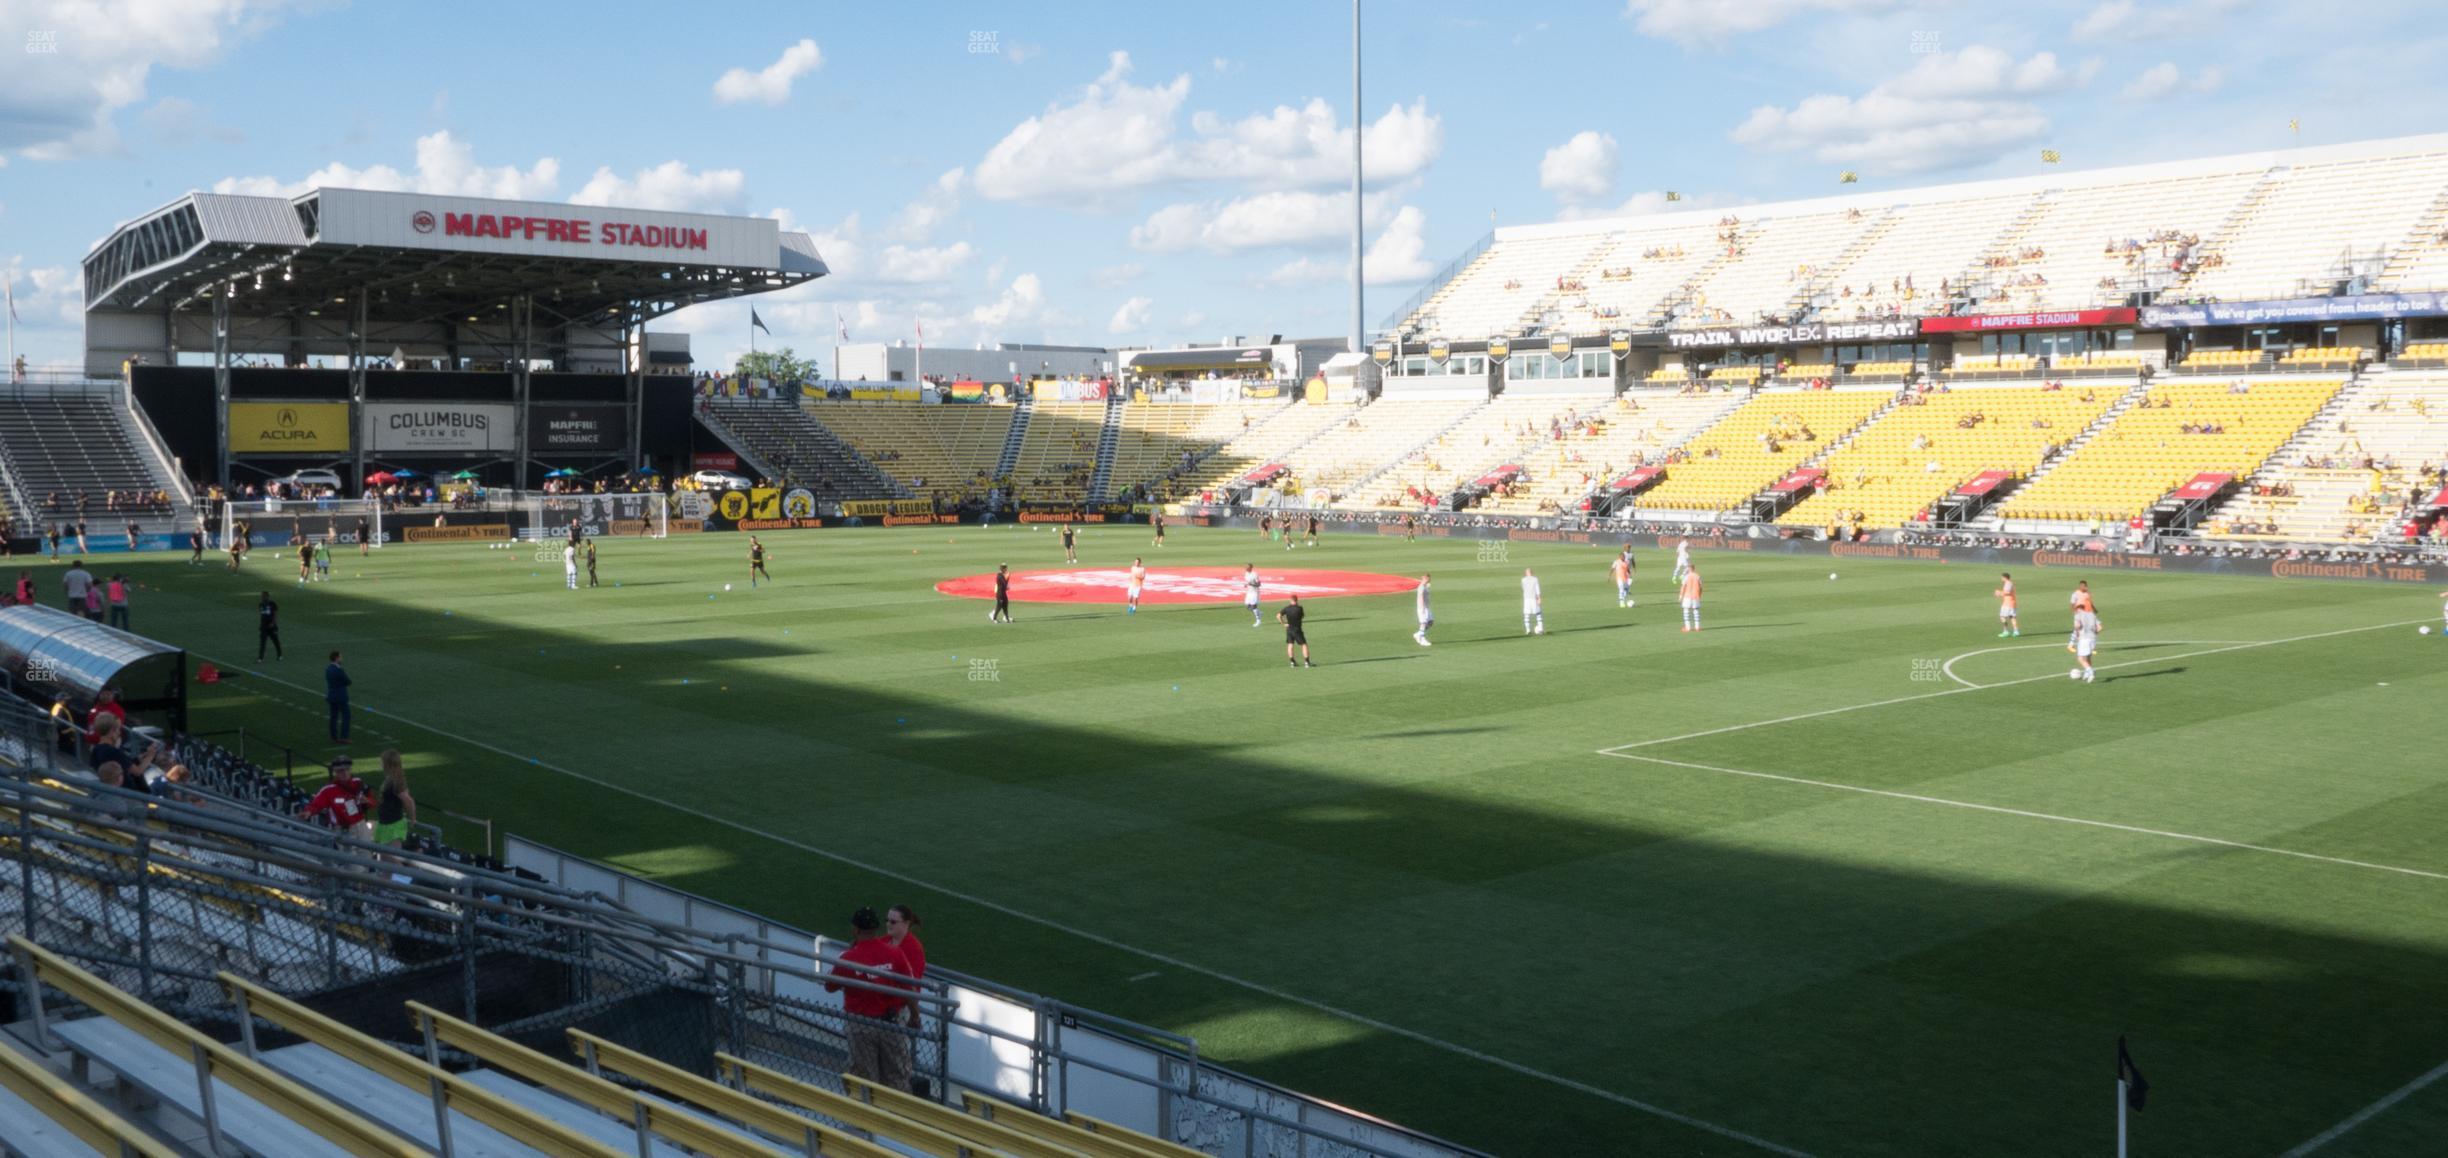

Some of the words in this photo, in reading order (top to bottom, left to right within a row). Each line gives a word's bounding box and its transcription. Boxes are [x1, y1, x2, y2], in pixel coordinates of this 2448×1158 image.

[445, 212, 591, 243] MAPFRE
[601, 223, 707, 250] STADIUM
[2213, 309, 2245, 320] We've
[2246, 309, 2263, 321] got
[2264, 308, 2284, 320] you
[2286, 302, 2327, 316] covered
[2328, 302, 2356, 314] from
[2356, 300, 2396, 313] header
[2397, 301, 2409, 311] to
[2411, 300, 2431, 310] toe
[1981, 316, 2034, 327] MAPFRE
[2035, 313, 2080, 325] STADIUM
[1669, 332, 1735, 347] TRAIN.
[1740, 326, 1823, 345] MYOPLEX.
[1826, 322, 1914, 339] REPEAT.
[390, 412, 486, 430] COLUMBUS
[260, 430, 317, 440] ACURA
[411, 429, 446, 438] CREW
[451, 430, 466, 438] SC
[549, 434, 599, 444] INSURANCE
[738, 518, 792, 531] Continental
[802, 519, 822, 528] TIRE
[883, 514, 932, 528] Continental
[939, 515, 960, 523] TIRE
[1019, 511, 1073, 524] Continental
[1085, 514, 1104, 522] TIRE
[407, 527, 471, 542] Continental
[482, 527, 507, 537] TIRE
[1728, 539, 1753, 549] TIRE
[1830, 541, 1899, 558] Continental
[1912, 548, 1940, 559] TIRE
[2032, 550, 2113, 568] Continental
[2128, 557, 2161, 569] TIRE
[2272, 559, 2367, 578] Continental
[2386, 567, 2427, 581] TIRE
